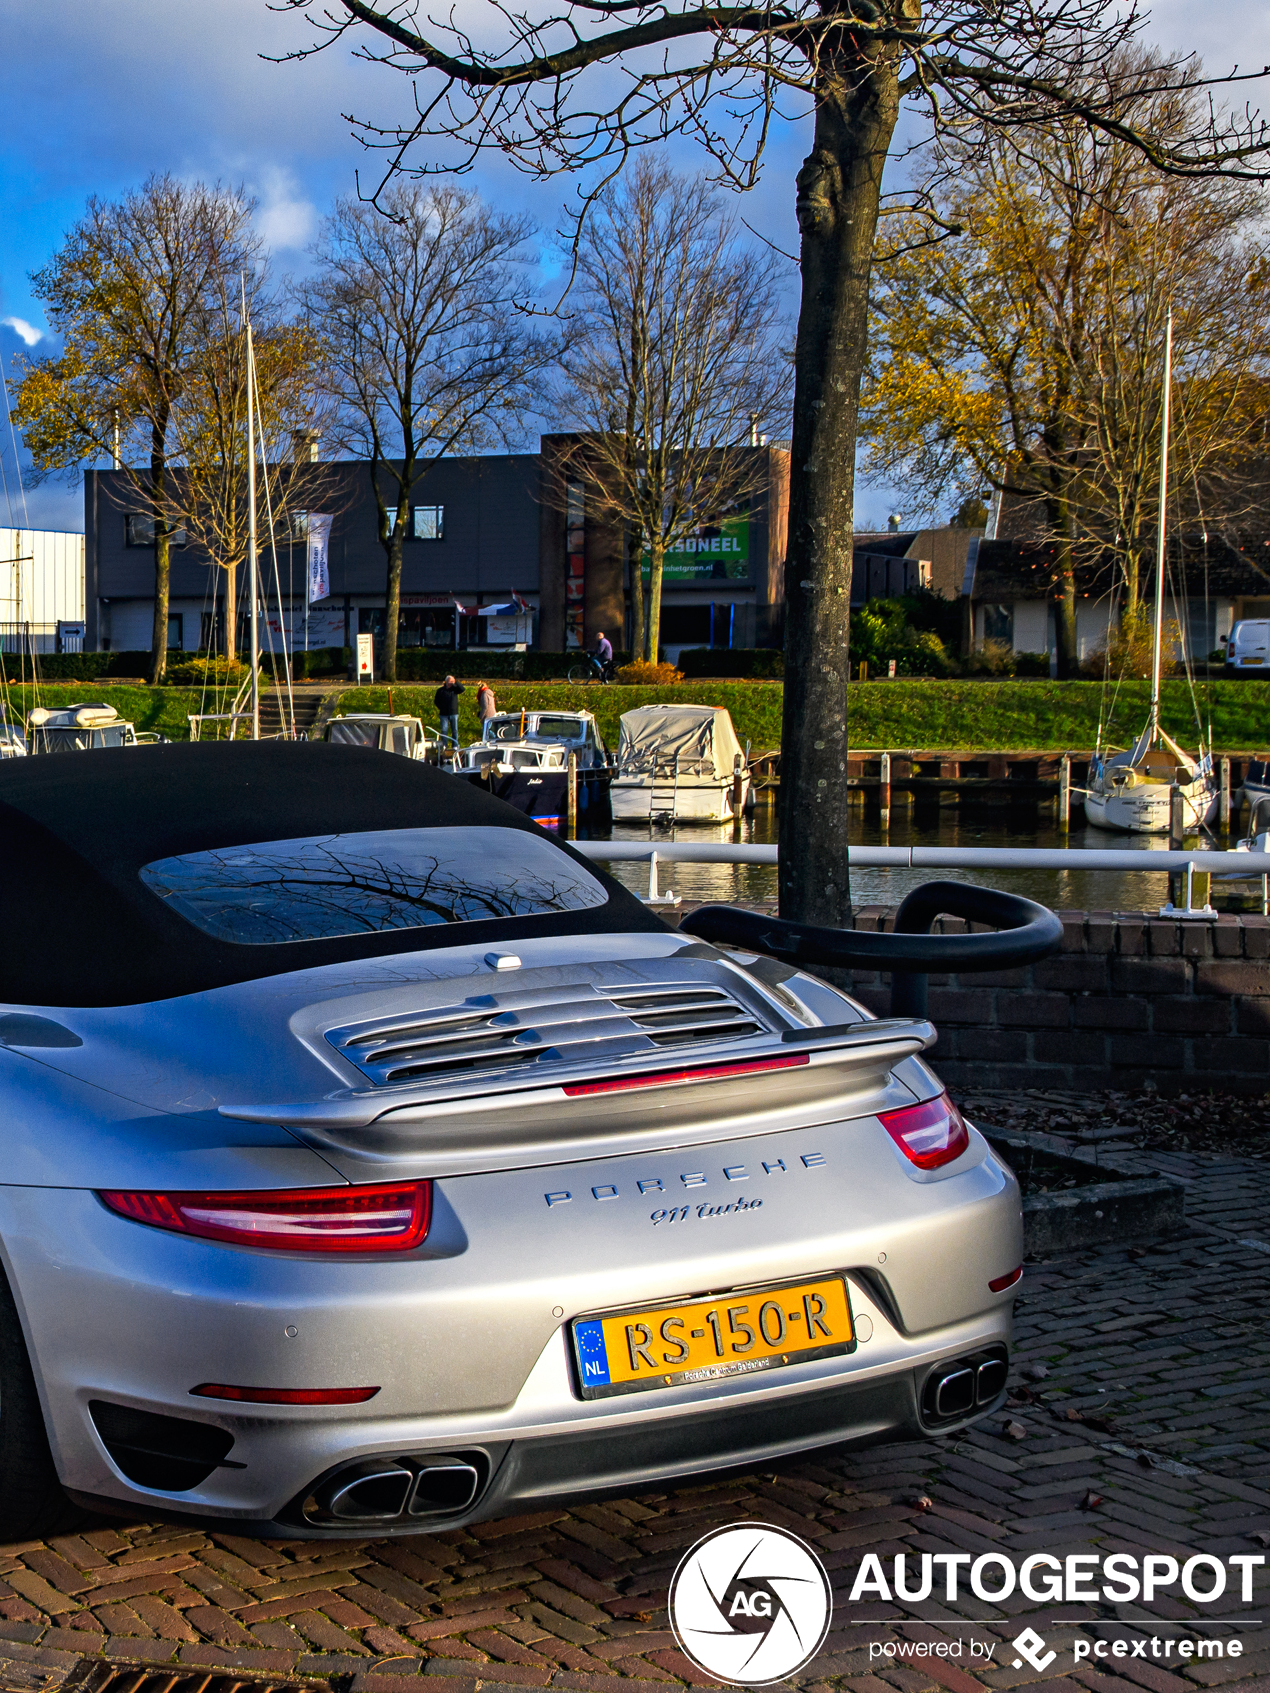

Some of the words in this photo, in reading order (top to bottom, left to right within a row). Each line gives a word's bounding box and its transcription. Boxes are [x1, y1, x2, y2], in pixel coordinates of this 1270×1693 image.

[544, 1152, 827, 1208] PORSCHE
[650, 1205, 690, 1226] 911
[695, 1197, 763, 1219] turbo
[624, 1293, 834, 1371] RS-150-R
[585, 1361, 606, 1377] NL
[684, 1369, 710, 1380] Porsche
